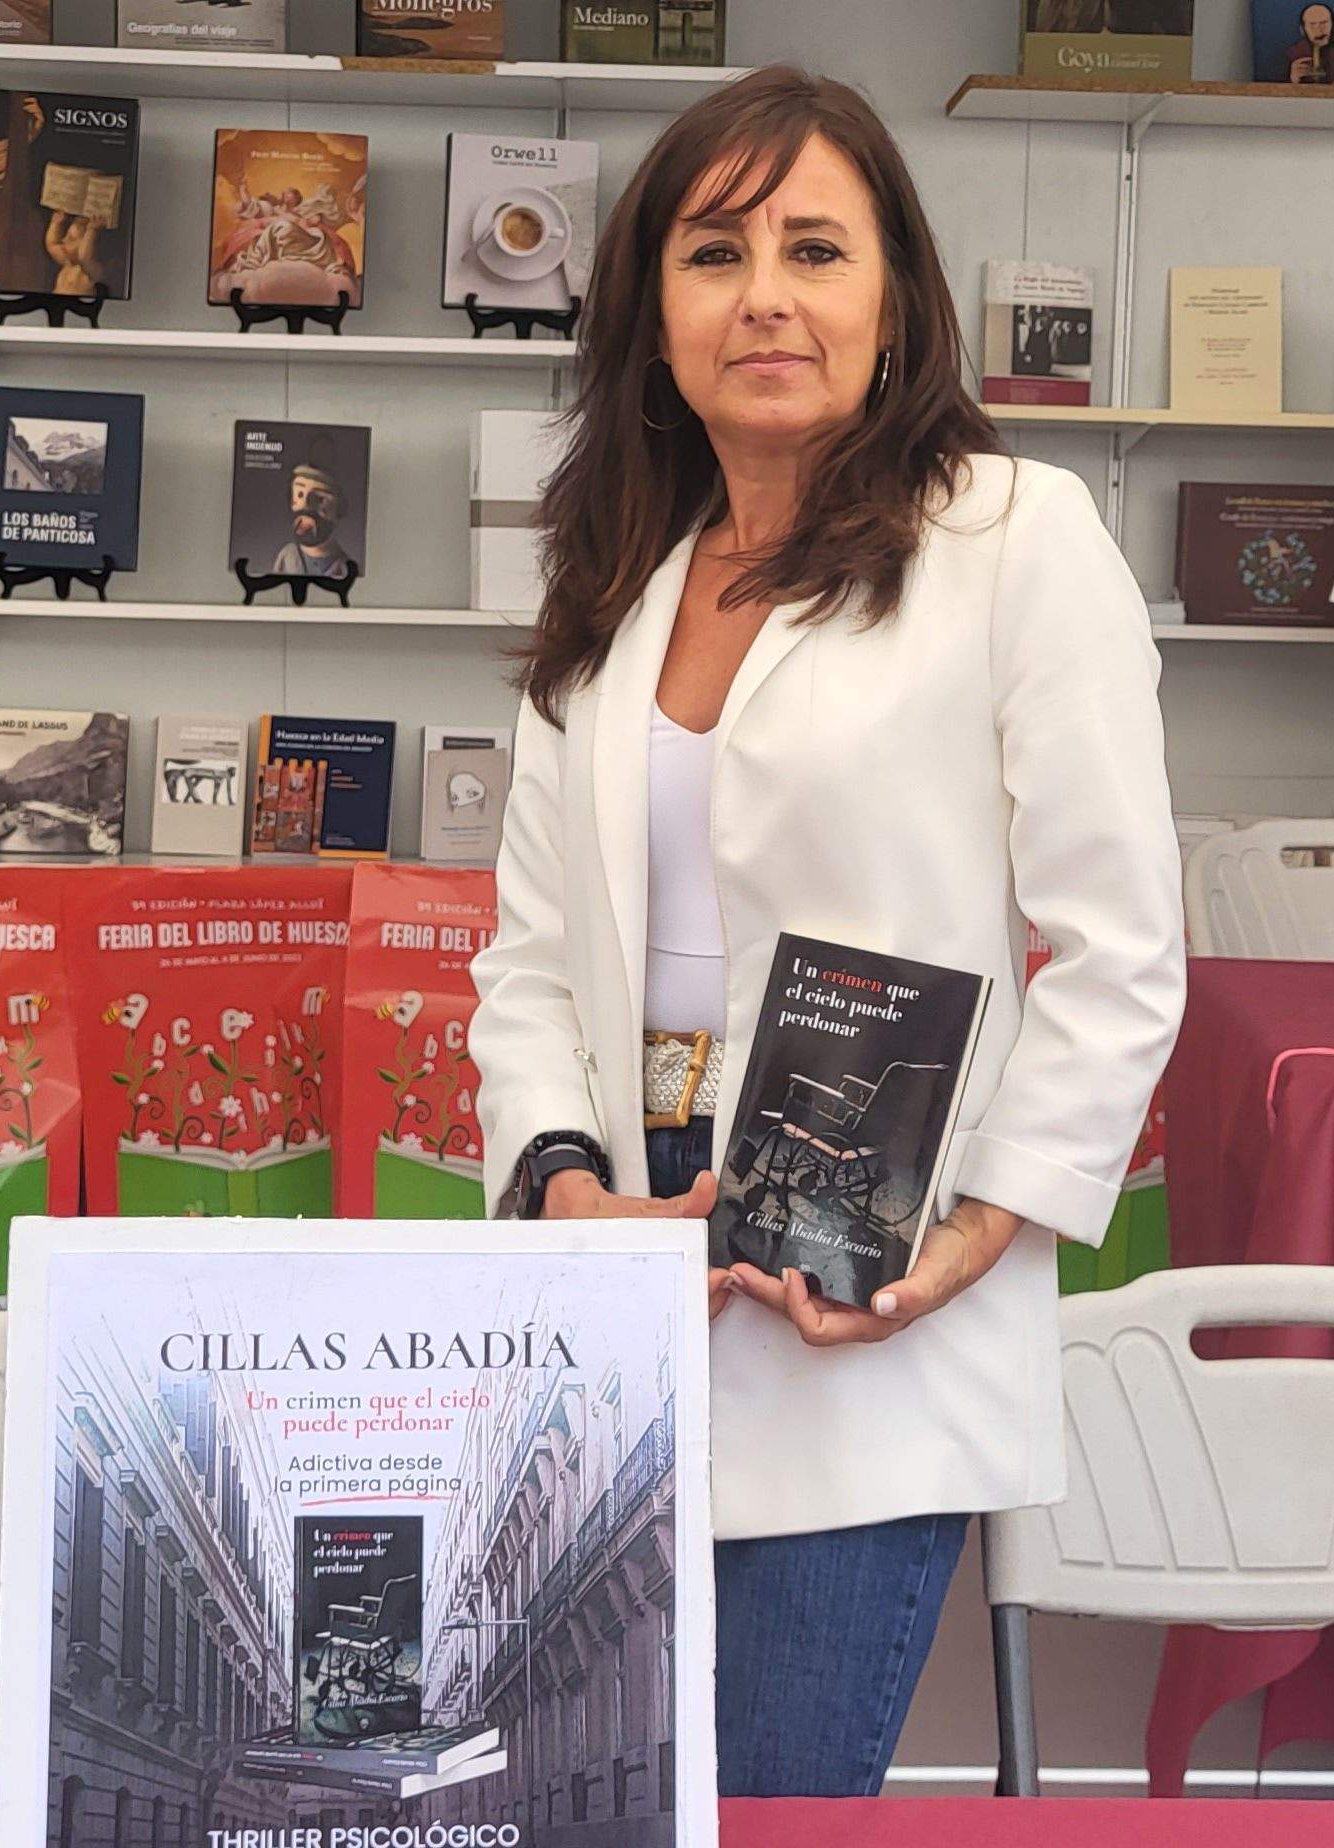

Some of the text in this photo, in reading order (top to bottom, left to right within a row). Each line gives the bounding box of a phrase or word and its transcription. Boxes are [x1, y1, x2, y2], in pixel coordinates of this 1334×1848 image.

[573, 7, 650, 25] Mediano
[191, 25, 208, 35] del
[1058, 46, 1110, 73] Goya
[54, 108, 128, 129] SIGNOS
[491, 145, 558, 162] Orwell
[2, 511, 78, 531] LOS BAÑOS
[2, 526, 97, 546] DE PANTICOSA
[98, 919, 351, 950] FERIA DEL LIBRO DE HUESC
[380, 922, 474, 954] FERIA DEL
[793, 957, 921, 1003] Un crimen que
[785, 982, 904, 1023] el cielo puede
[778, 1010, 861, 1039] perdonar
[746, 1210, 786, 1233] Cillas
[833, 1233, 883, 1260] Escario
[160, 1322, 579, 1373] CILLAS ABADÍA
[247, 1387, 491, 1417] Un crimen que el cielo
[282, 1410, 455, 1440] puede perdonar
[288, 1453, 444, 1472] Adictiva desde
[274, 1474, 463, 1498] la primera página
[314, 1529, 331, 1541] Un
[373, 1532, 394, 1545] que
[313, 1545, 388, 1561] el cielo puede
[313, 1561, 365, 1579] perdonar
[206, 1819, 521, 1848] THRILLER PSICOLÓGICO
